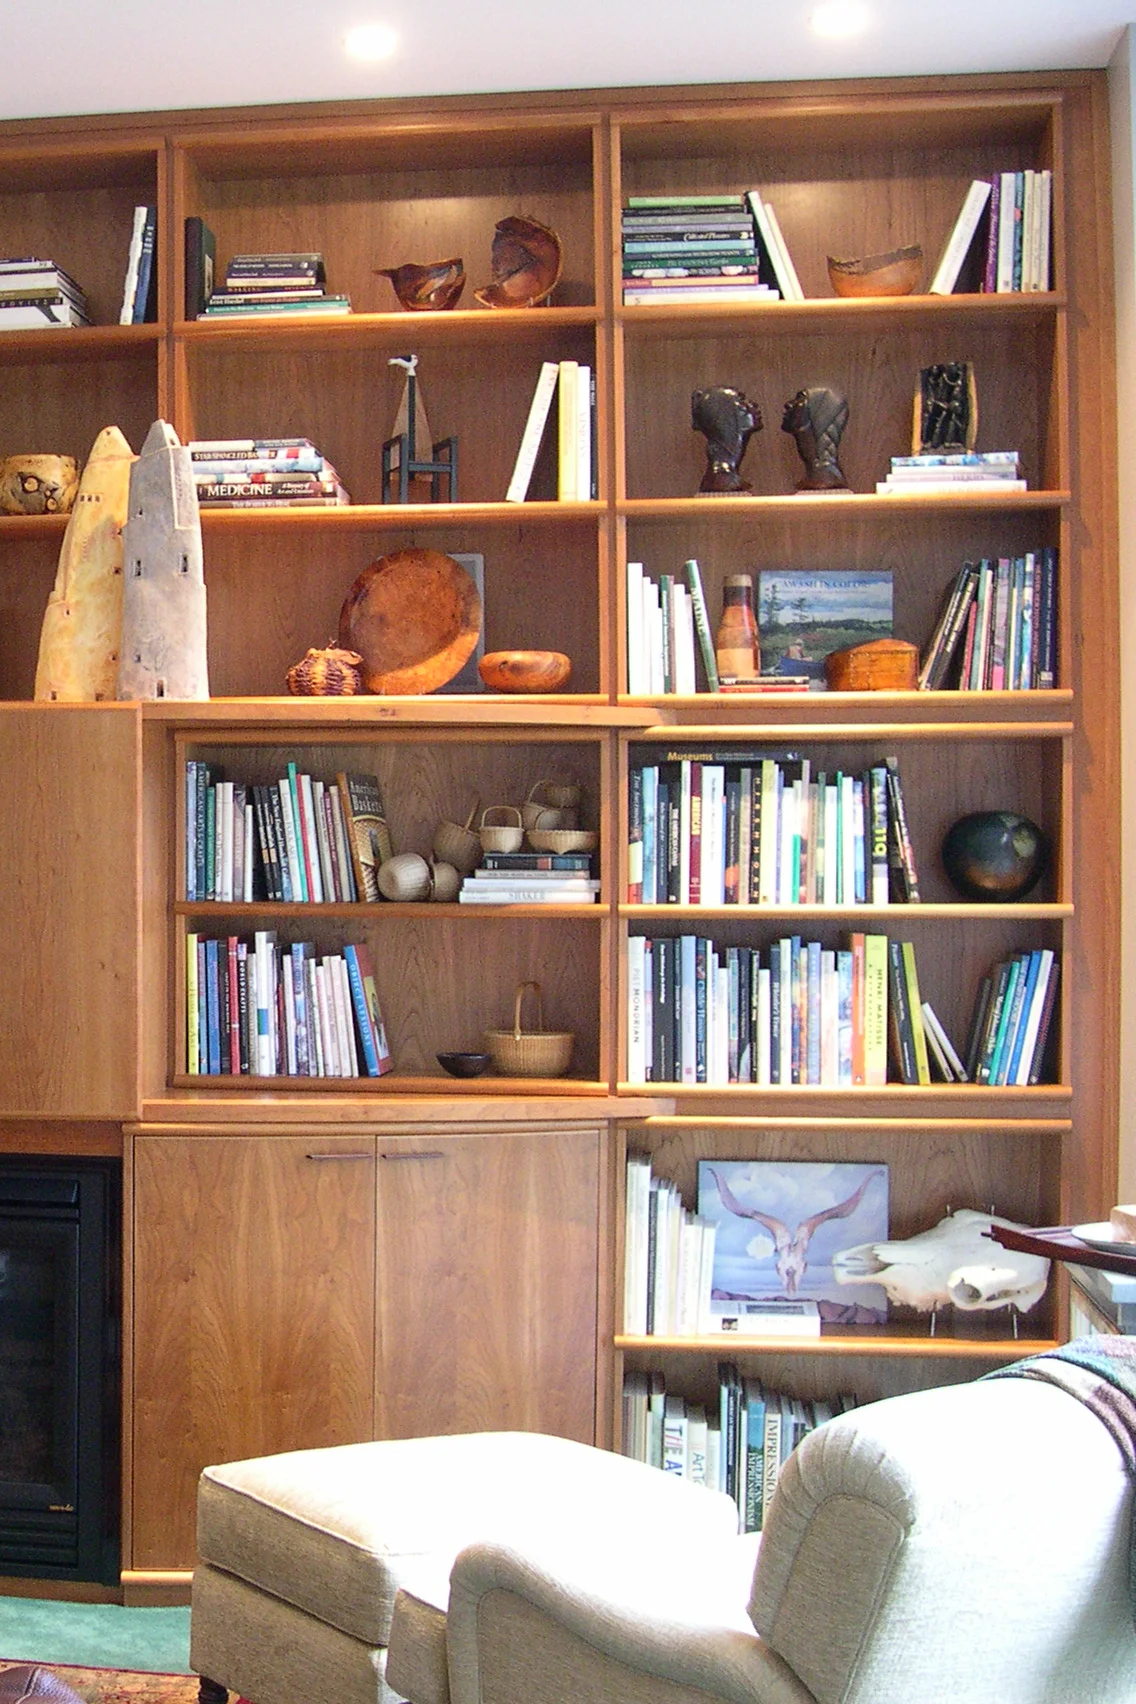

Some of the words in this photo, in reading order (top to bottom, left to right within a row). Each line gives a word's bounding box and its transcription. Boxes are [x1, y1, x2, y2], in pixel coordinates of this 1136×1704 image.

[207, 484, 273, 496] MEDICINE
[668, 752, 713, 762] Museums
[350, 964, 361, 999] OBJECT
[357, 1004, 371, 1046] LESSONS
[697, 980, 705, 1008] Childe
[697, 1010, 706, 1041] Hassam
[664, 1425, 683, 1456] THE
[692, 1452, 705, 1472] Art
[766, 1419, 778, 1508] IMPRESSION
[746, 1452, 755, 1526] IMPRESSIONISM
